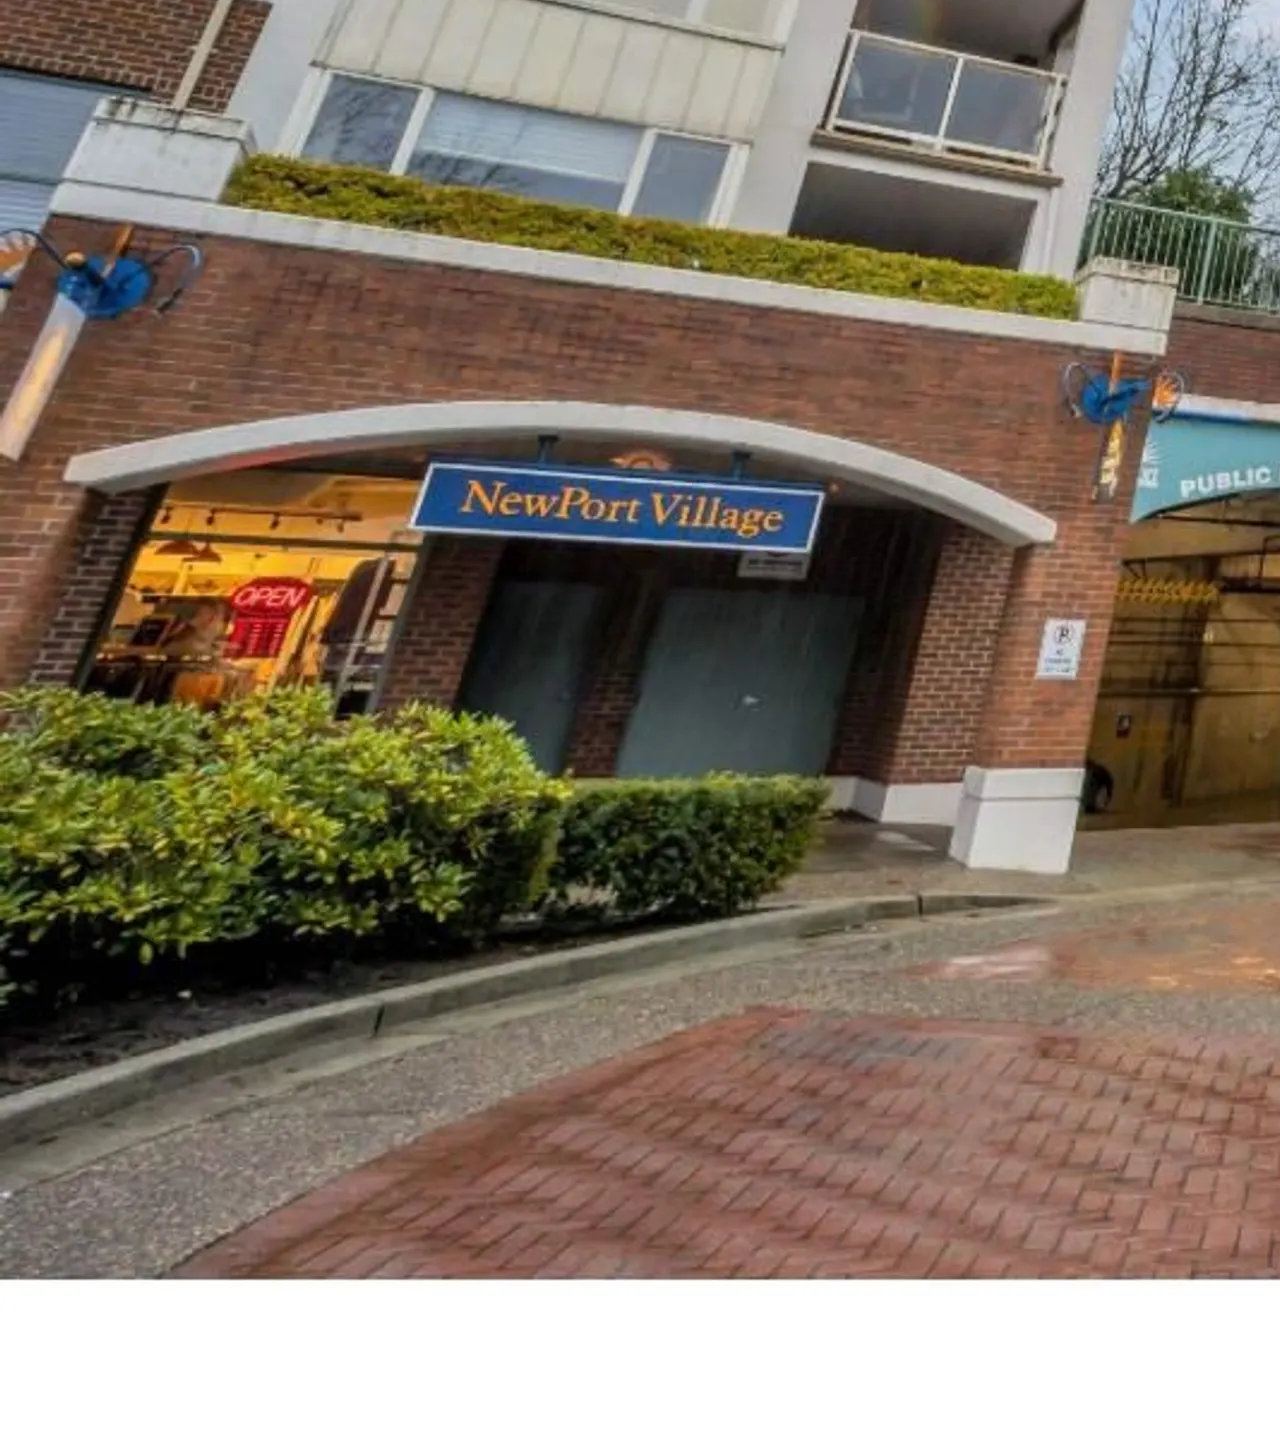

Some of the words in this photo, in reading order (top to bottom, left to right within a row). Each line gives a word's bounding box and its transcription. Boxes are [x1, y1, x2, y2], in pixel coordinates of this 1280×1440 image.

[1180, 467, 1272, 499] PUBLIC
[460, 478, 642, 524] NewPort
[651, 491, 784, 538] Village
[233, 586, 308, 608] OPEN
